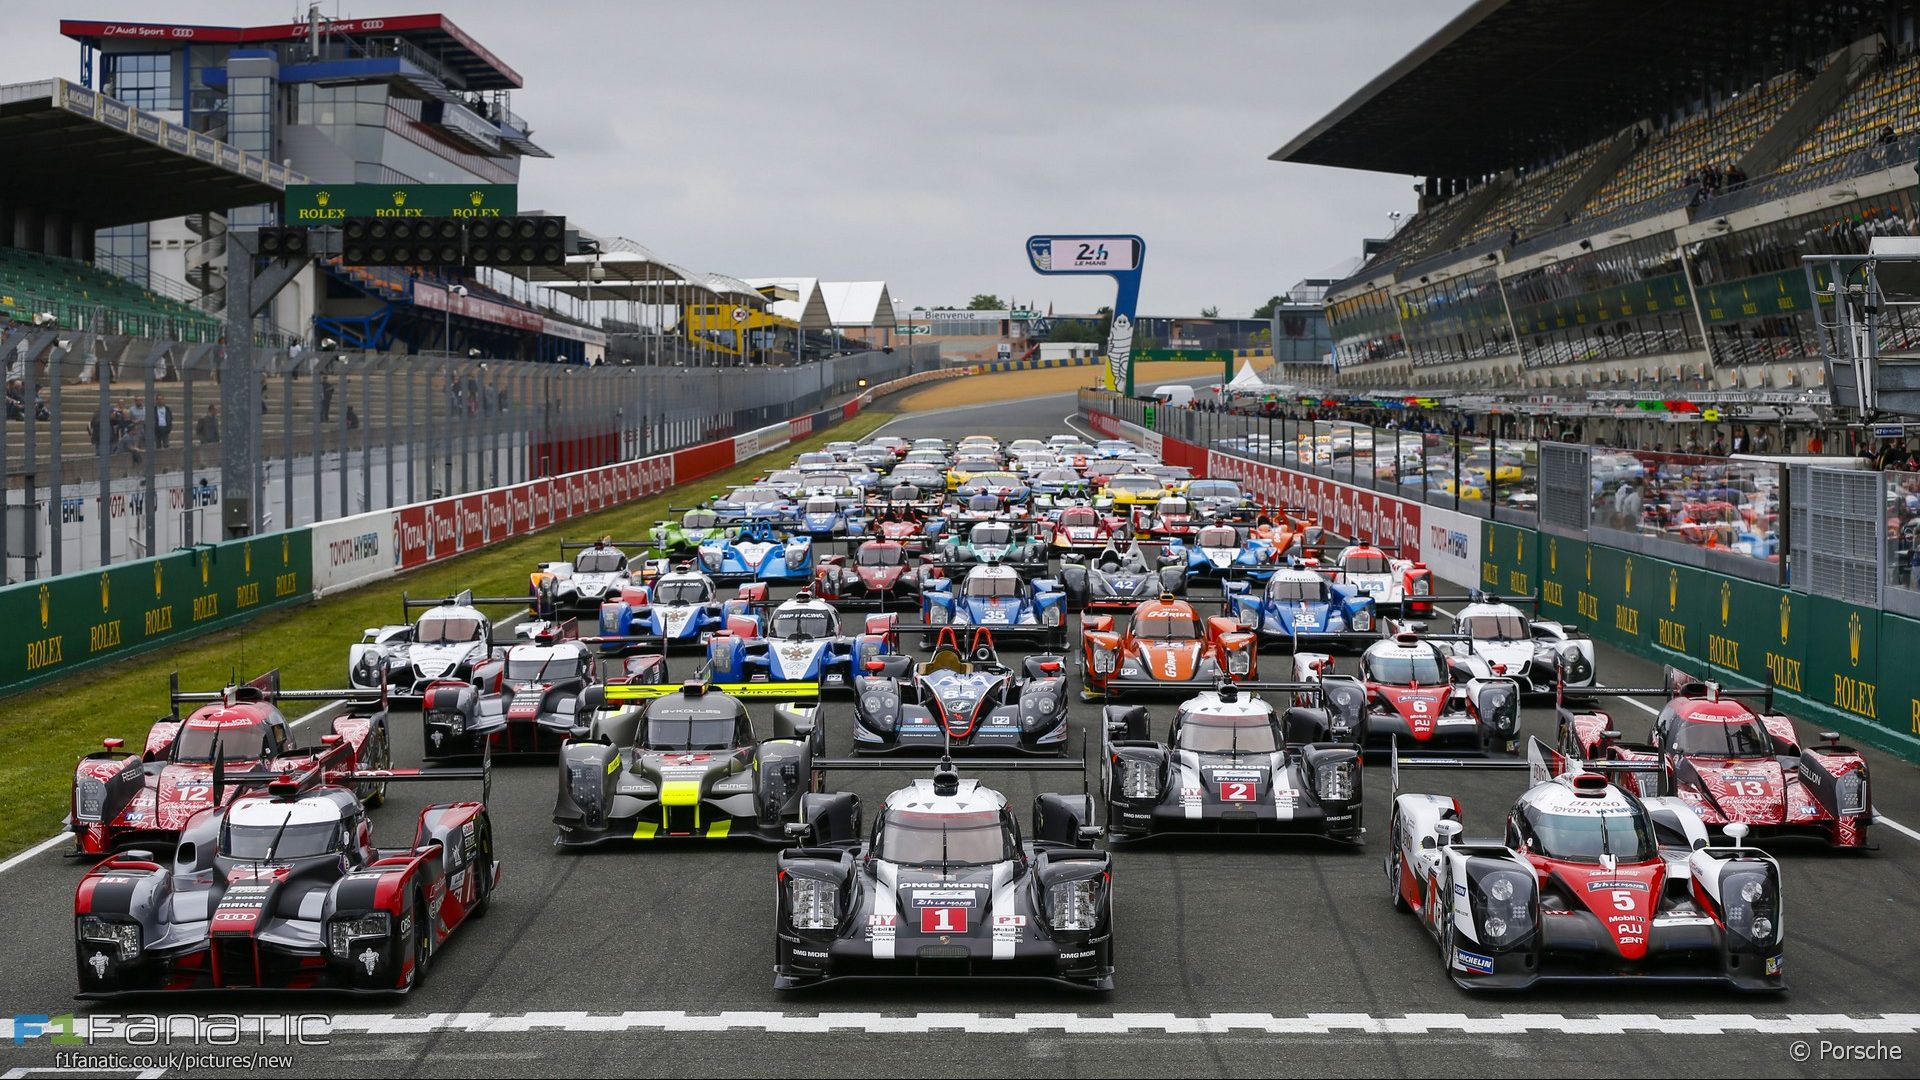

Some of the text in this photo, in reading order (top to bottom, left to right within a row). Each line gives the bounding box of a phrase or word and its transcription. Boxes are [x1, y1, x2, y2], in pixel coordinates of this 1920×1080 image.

[138, 28, 164, 36] Sport
[300, 208, 346, 218] ROLEX
[376, 208, 423, 217] ROLEX
[453, 208, 500, 217] ROLEX
[1076, 243, 1108, 260] 24h
[925, 312, 975, 320] Bienvenue
[96, 496, 126, 520] TOTA
[490, 504, 506, 528] TOTAL
[1358, 504, 1372, 533] TOTAL
[435, 515, 455, 540] TOTAL
[464, 508, 482, 535] TOTAL
[1380, 510, 1394, 542] TOTAL
[403, 522, 425, 550] TOTAL
[1403, 516, 1419, 550] TOTAL
[1431, 526, 1468, 559] TOYOTA HYBRID
[330, 532, 378, 567] TOYOTA HYBRID
[276, 572, 296, 598] ROLEX
[1115, 580, 1134, 589] 42
[1484, 562, 1498, 586] ROLEX
[1511, 570, 1528, 595] ROLEX
[237, 582, 259, 608] ROLEX
[1544, 580, 1563, 606] ROLEX
[193, 593, 218, 622] ROLEX
[985, 610, 1006, 619] 35
[1578, 592, 1598, 620] ROLEX
[145, 606, 172, 636] ROLEX
[1295, 614, 1315, 623] 36
[1616, 604, 1638, 636] ROLEX
[90, 620, 120, 652] ROLEX
[1659, 618, 1686, 652] ROLEX
[27, 636, 62, 670] ROLEX
[1709, 634, 1740, 670] ROLEX
[943, 690, 977, 699] 84
[1834, 673, 1876, 718] ROLEX
[1413, 701, 1428, 712] 6
[994, 716, 1008, 724] P2
[177, 786, 209, 800] 12
[1180, 788, 1200, 796] HY
[1229, 784, 1248, 800] 2
[1730, 780, 1764, 796] 13
[1552, 806, 1590, 814] TOYOTA
[943, 882, 989, 890] MORI
[1612, 890, 1636, 911] 5
[868, 915, 896, 926] HY
[934, 909, 954, 930] 1
[998, 916, 1020, 924] P1
[793, 948, 806, 957] DMG
[1459, 952, 1492, 968] MICHELIN
